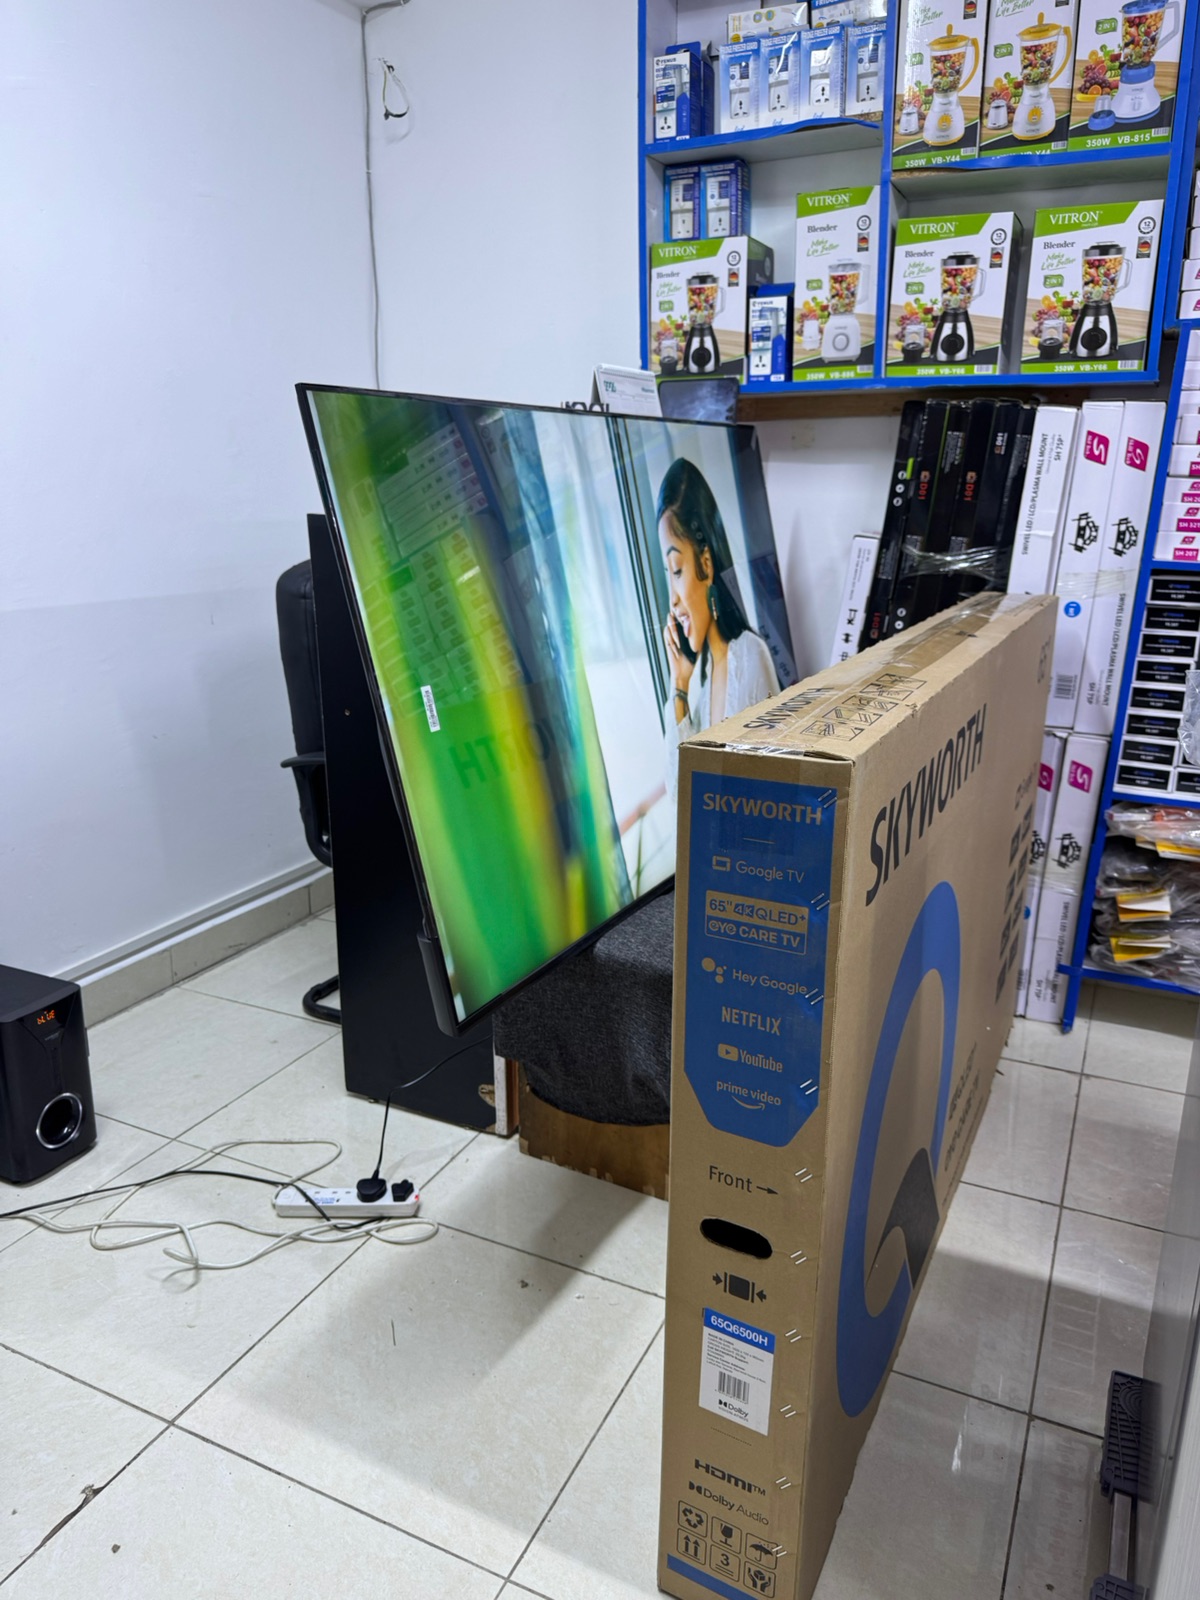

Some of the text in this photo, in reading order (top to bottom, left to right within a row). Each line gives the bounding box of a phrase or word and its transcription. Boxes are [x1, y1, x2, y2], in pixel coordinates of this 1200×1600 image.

[1086, 133, 1150, 147] 350W VB-815
[905, 155, 960, 168] 350W VB-Y44
[807, 193, 850, 207] VITRON
[1050, 211, 1099, 224] VITRON
[808, 224, 837, 233] Blender
[910, 222, 955, 234] VITRON
[658, 246, 697, 257] VITRON
[1043, 240, 1076, 249] Blender
[905, 250, 934, 258] Blender
[656, 271, 680, 279] Blender
[1038, 433, 1049, 457] MOUNT
[743, 687, 835, 730] SKYWORTH
[703, 793, 822, 825] SKYWORTH
[865, 702, 987, 907] SKYWORTH
[735, 861, 805, 883] Google TV
[709, 899, 732, 913] 65"
[739, 925, 777, 943] CARE
[781, 934, 800, 947] TV
[732, 969, 808, 995] Hey Google
[722, 1006, 782, 1035] NETFLIX
[739, 1049, 783, 1073] YouTube
[716, 1080, 782, 1106] prime video
[709, 1165, 752, 1193] Front
[711, 1315, 768, 1346] 65Q6500H
[728, 1403, 749, 1417] Dolby
[703, 1489, 769, 1526] Dolby Audio
[720, 1554, 730, 1566] 3
